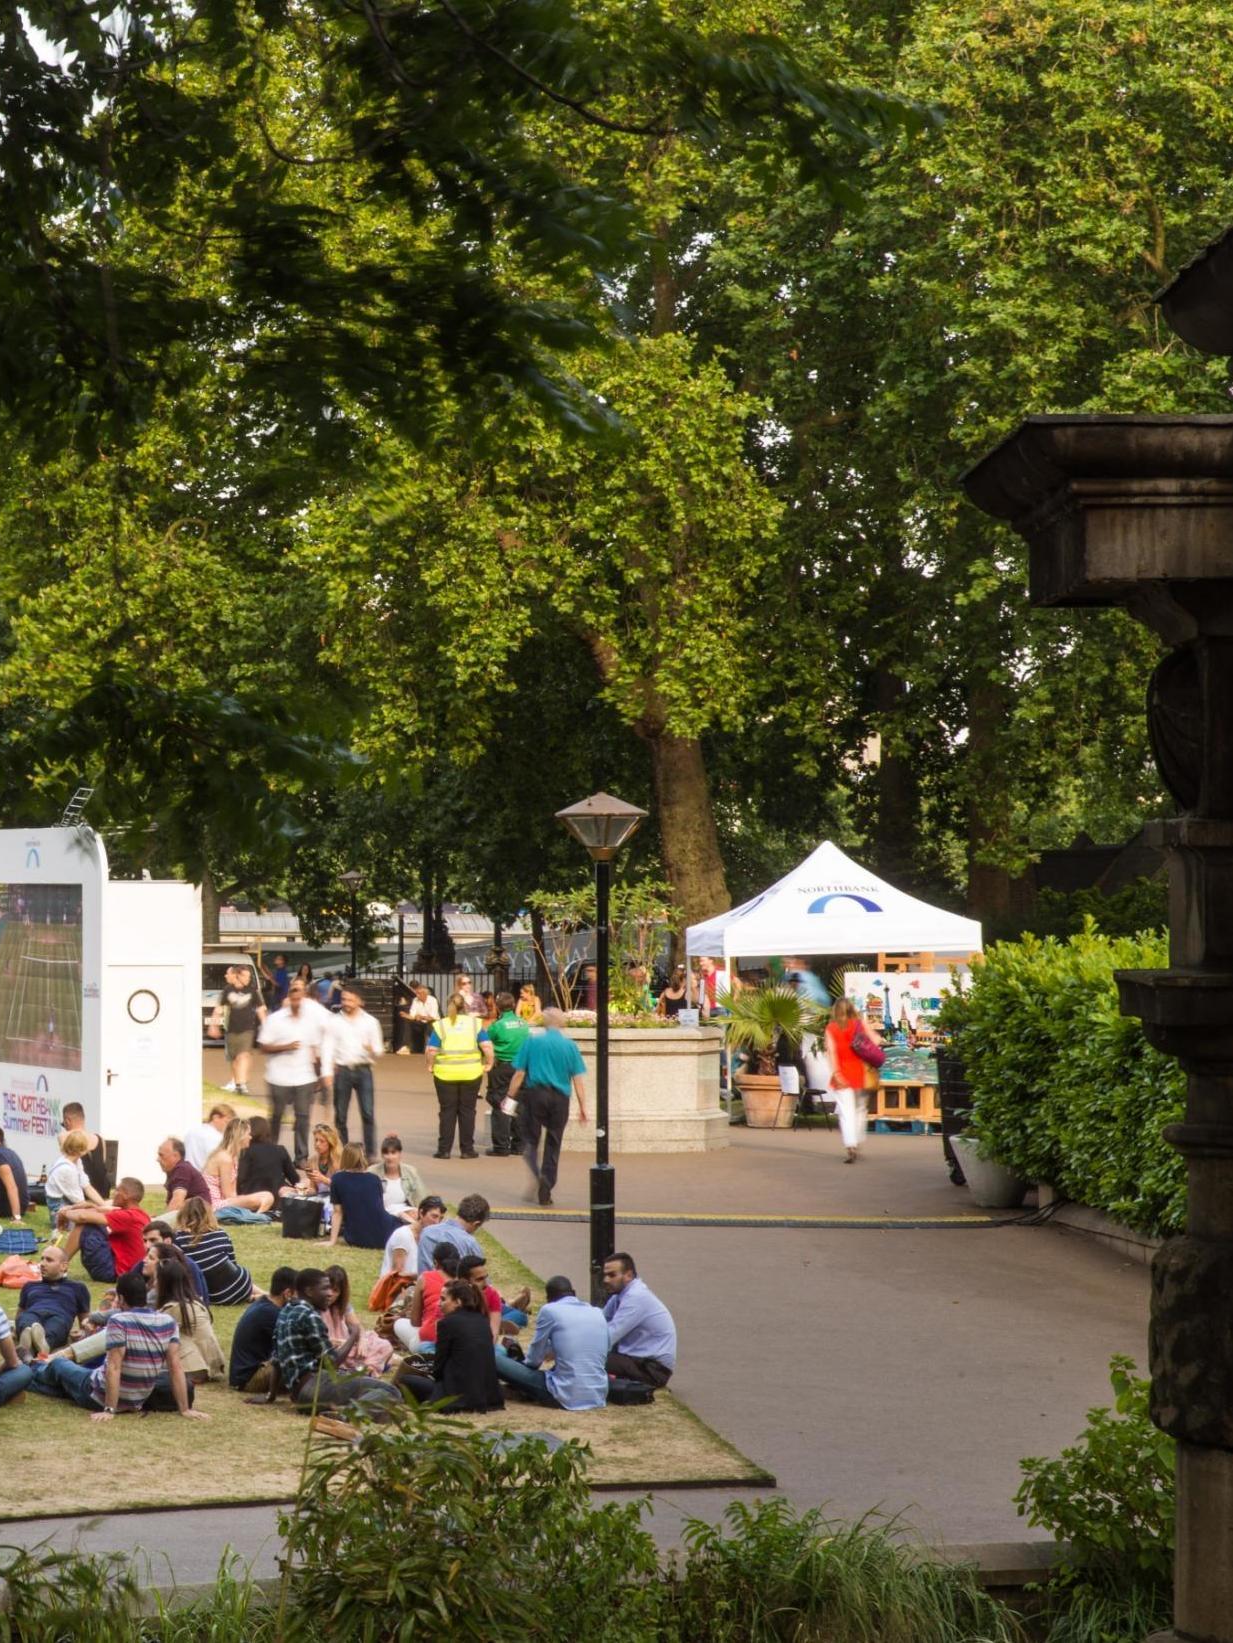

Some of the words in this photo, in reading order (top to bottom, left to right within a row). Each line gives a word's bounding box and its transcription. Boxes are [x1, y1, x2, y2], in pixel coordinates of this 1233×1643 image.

[797, 885, 880, 895] NORTHBANK
[3, 1092, 16, 1111] THE
[18, 1094, 62, 1117] NORTHBANK
